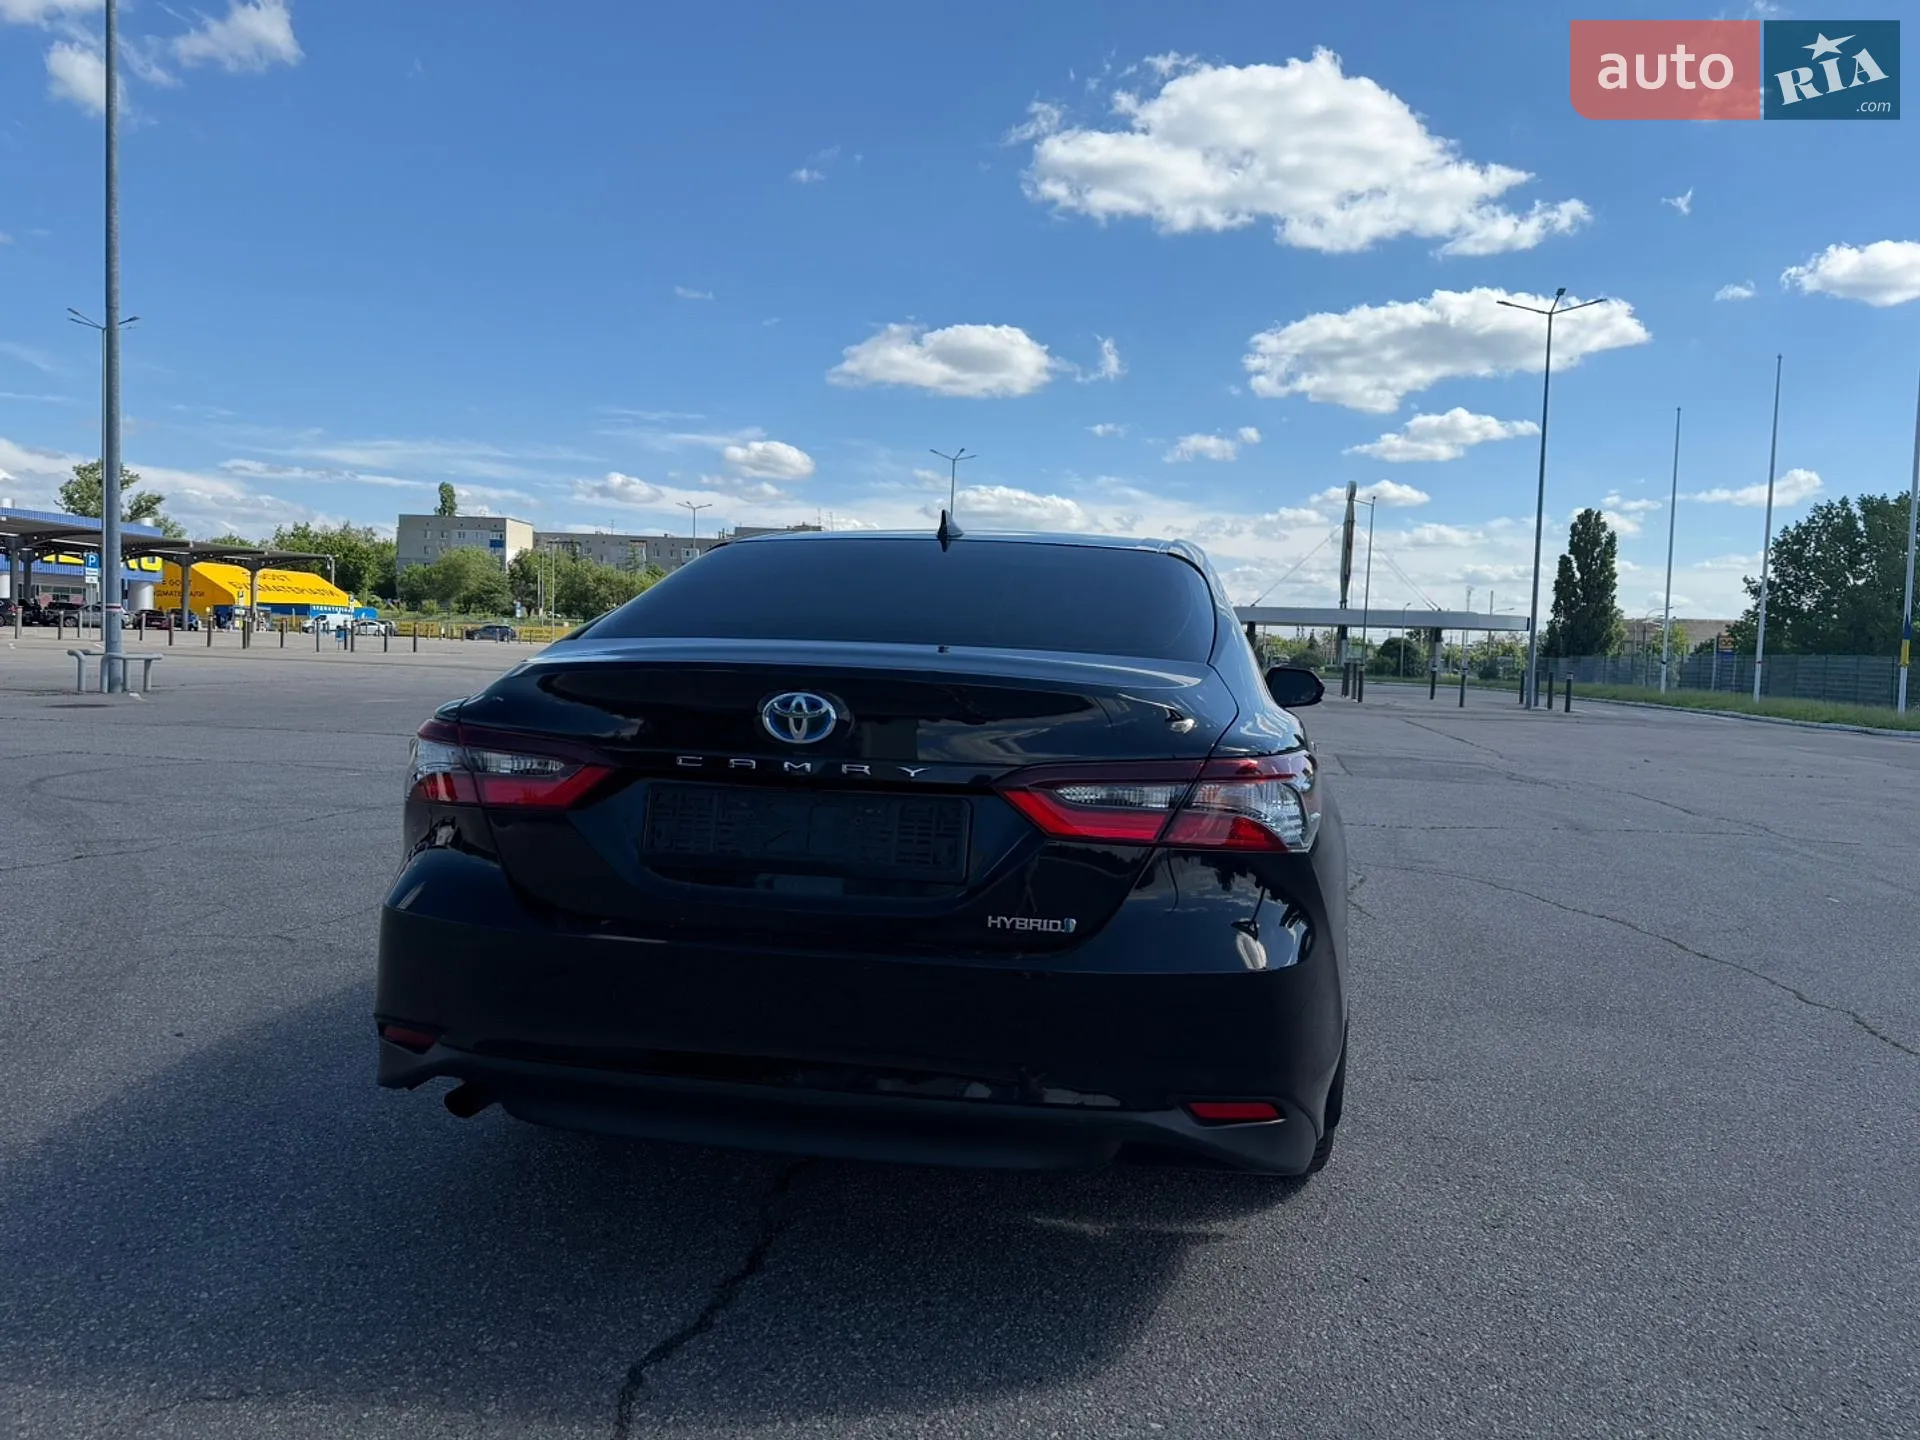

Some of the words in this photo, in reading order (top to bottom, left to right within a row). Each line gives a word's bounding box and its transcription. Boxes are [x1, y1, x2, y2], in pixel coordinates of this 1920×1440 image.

[88, 554, 96, 567] P
[676, 756, 930, 777] CAMRY
[987, 915, 1062, 932] HYBRID
